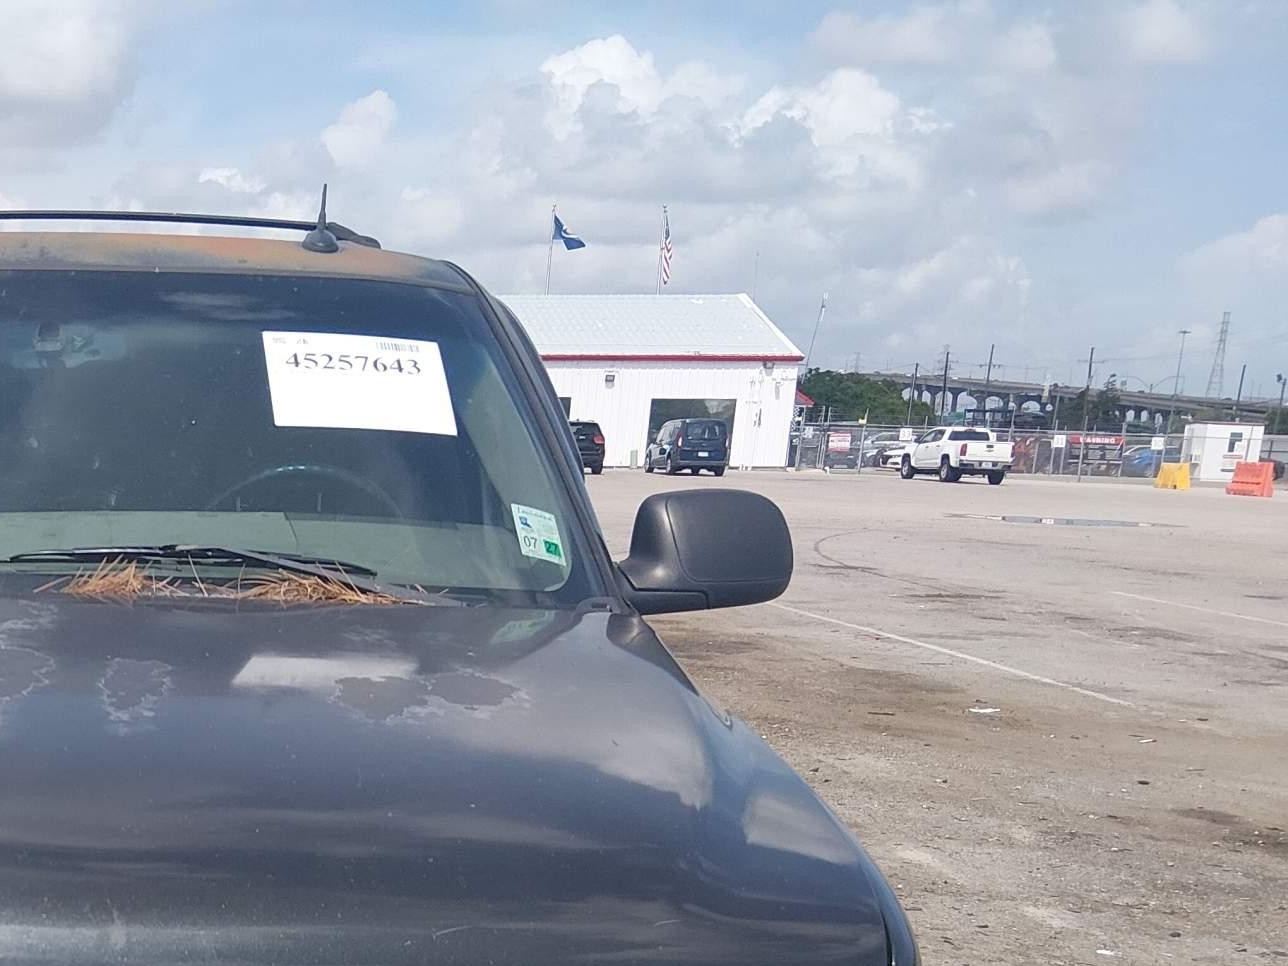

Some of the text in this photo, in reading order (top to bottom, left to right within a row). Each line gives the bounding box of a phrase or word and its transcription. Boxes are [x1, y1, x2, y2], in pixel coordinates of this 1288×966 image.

[285, 352, 422, 375] 45257643
[523, 536, 558, 555] 07 27
